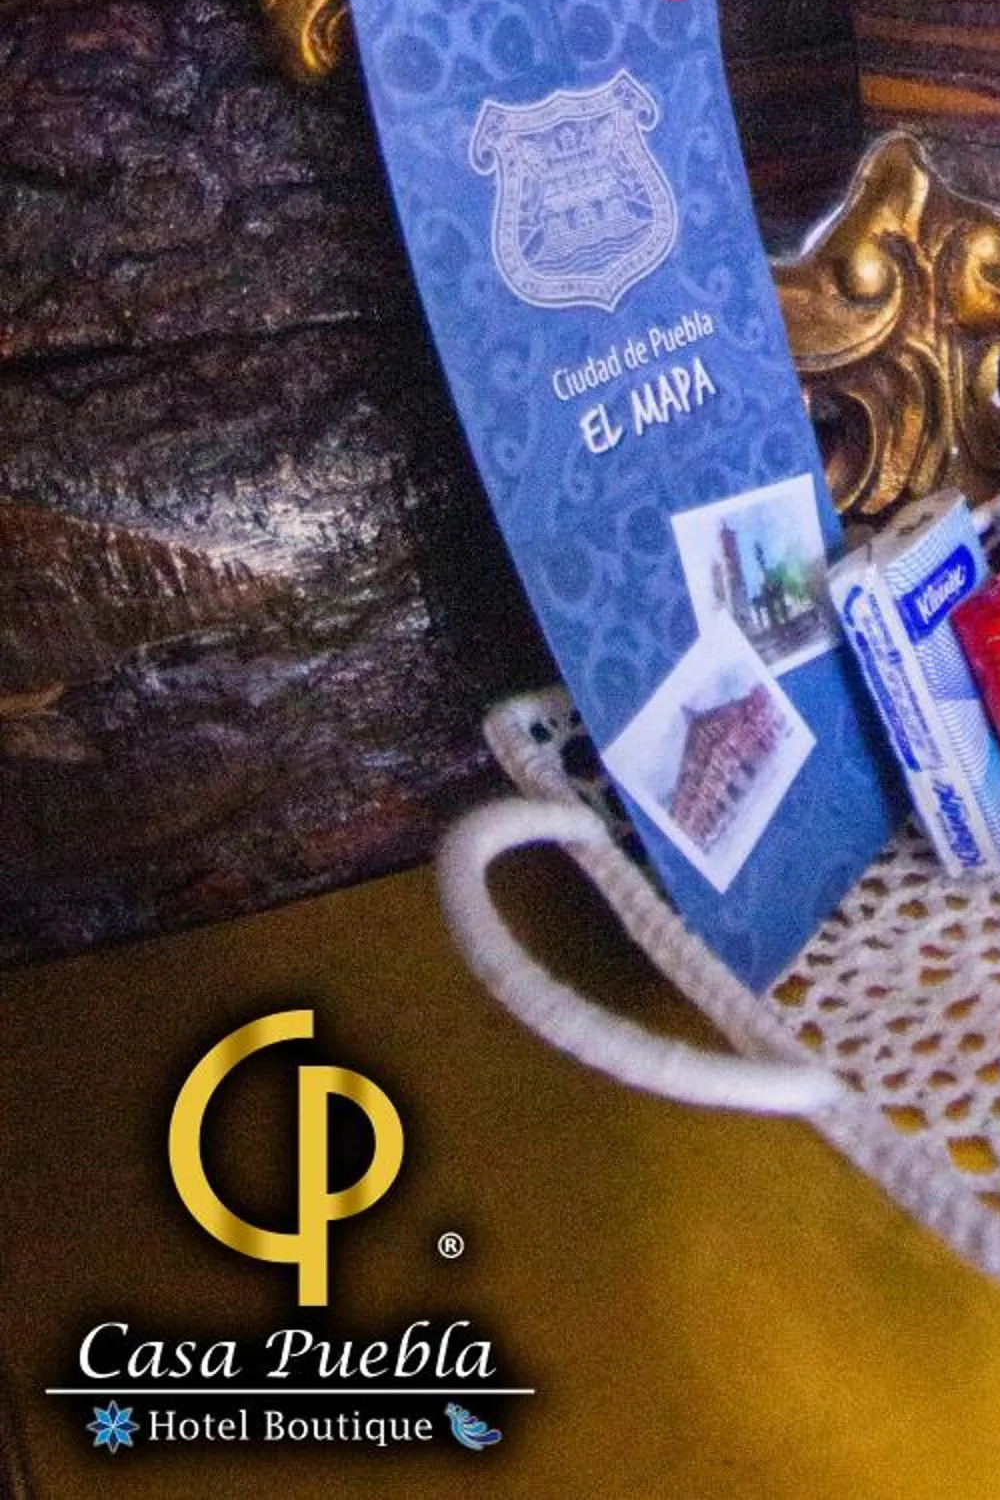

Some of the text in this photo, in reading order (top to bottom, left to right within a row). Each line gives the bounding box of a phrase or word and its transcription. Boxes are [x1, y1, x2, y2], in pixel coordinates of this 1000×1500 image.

[552, 309, 714, 402] Ciudad de Puebla
[579, 355, 718, 455] EL MAPA
